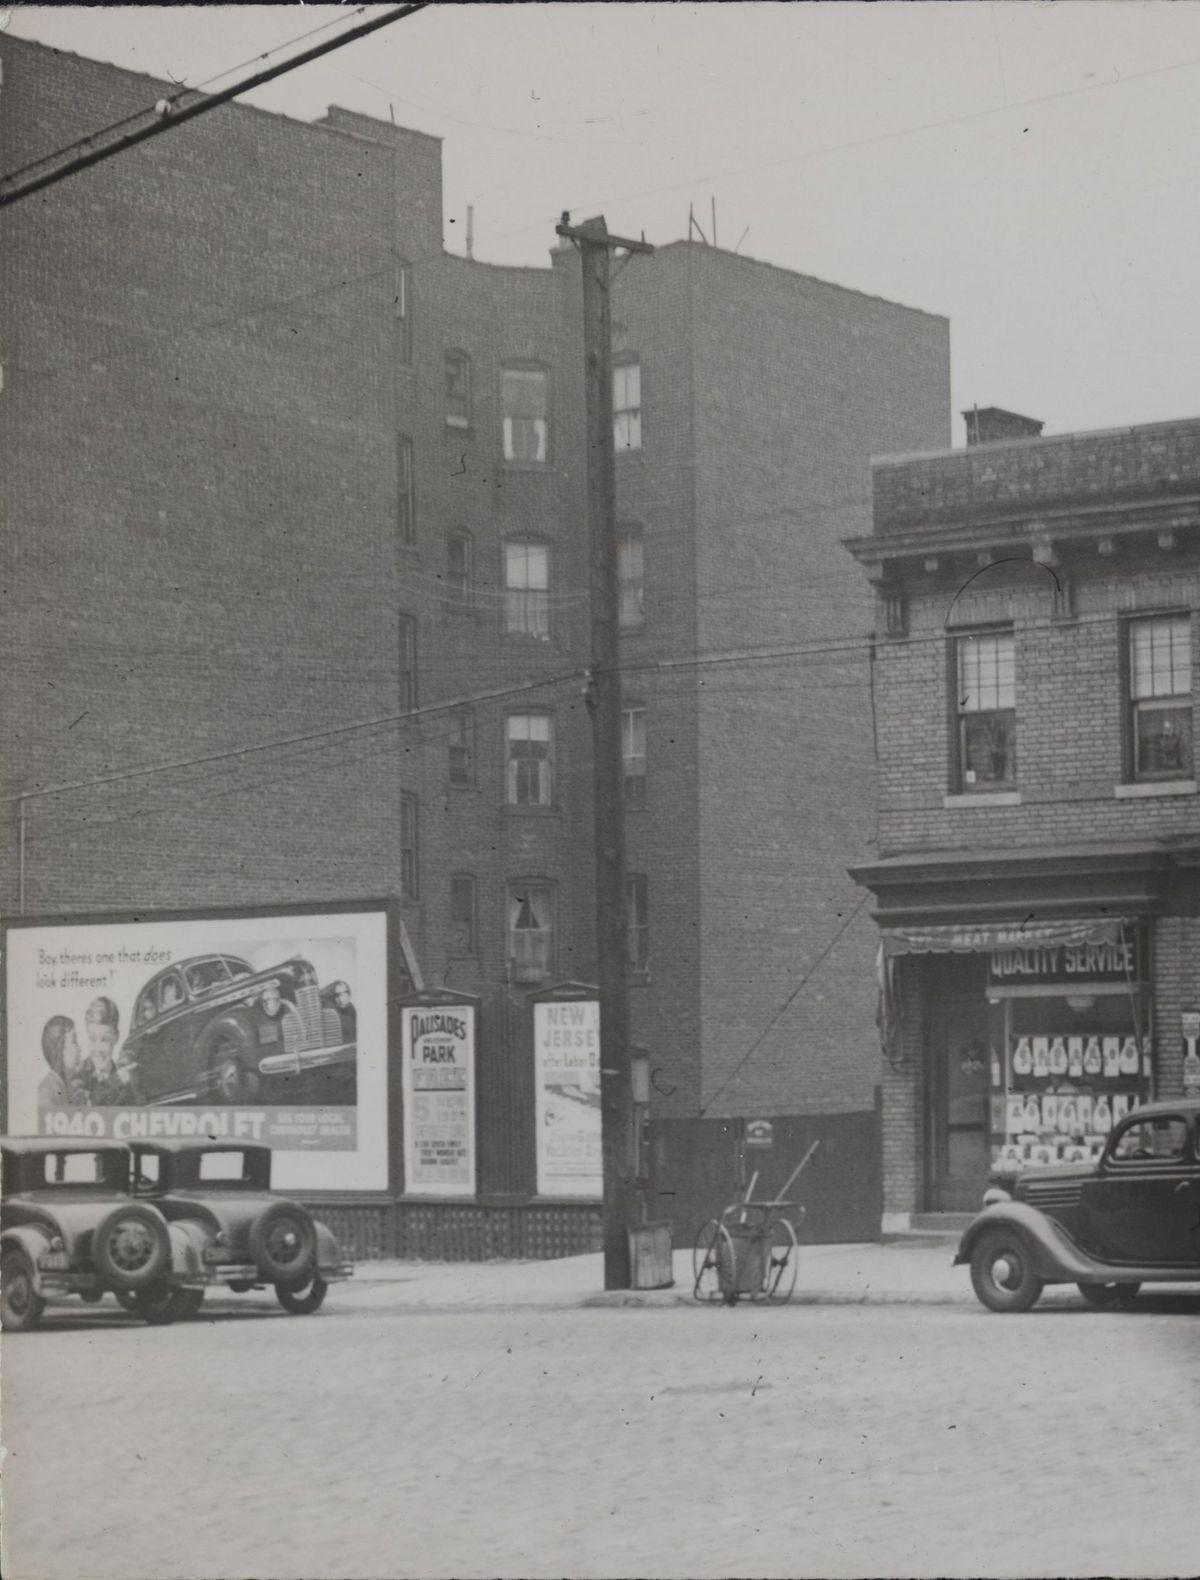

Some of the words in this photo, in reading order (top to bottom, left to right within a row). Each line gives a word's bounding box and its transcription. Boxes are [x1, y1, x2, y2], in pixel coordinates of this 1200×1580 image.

[953, 932, 990, 945] MEAT
[997, 929, 1053, 943] MARKET
[96, 953, 115, 964] one
[118, 945, 140, 962] that
[143, 945, 172, 963] does
[991, 946, 1058, 977] QUALITY
[1065, 944, 1134, 972] SERVICE
[36, 971, 56, 987] look
[547, 1006, 585, 1026] NEW
[411, 1015, 467, 1059] PALISADES
[543, 1029, 600, 1047] JERSE
[423, 1045, 456, 1063] PARK
[44, 1112, 106, 1137] 1940
[114, 1112, 266, 1139] CHEVROLET
